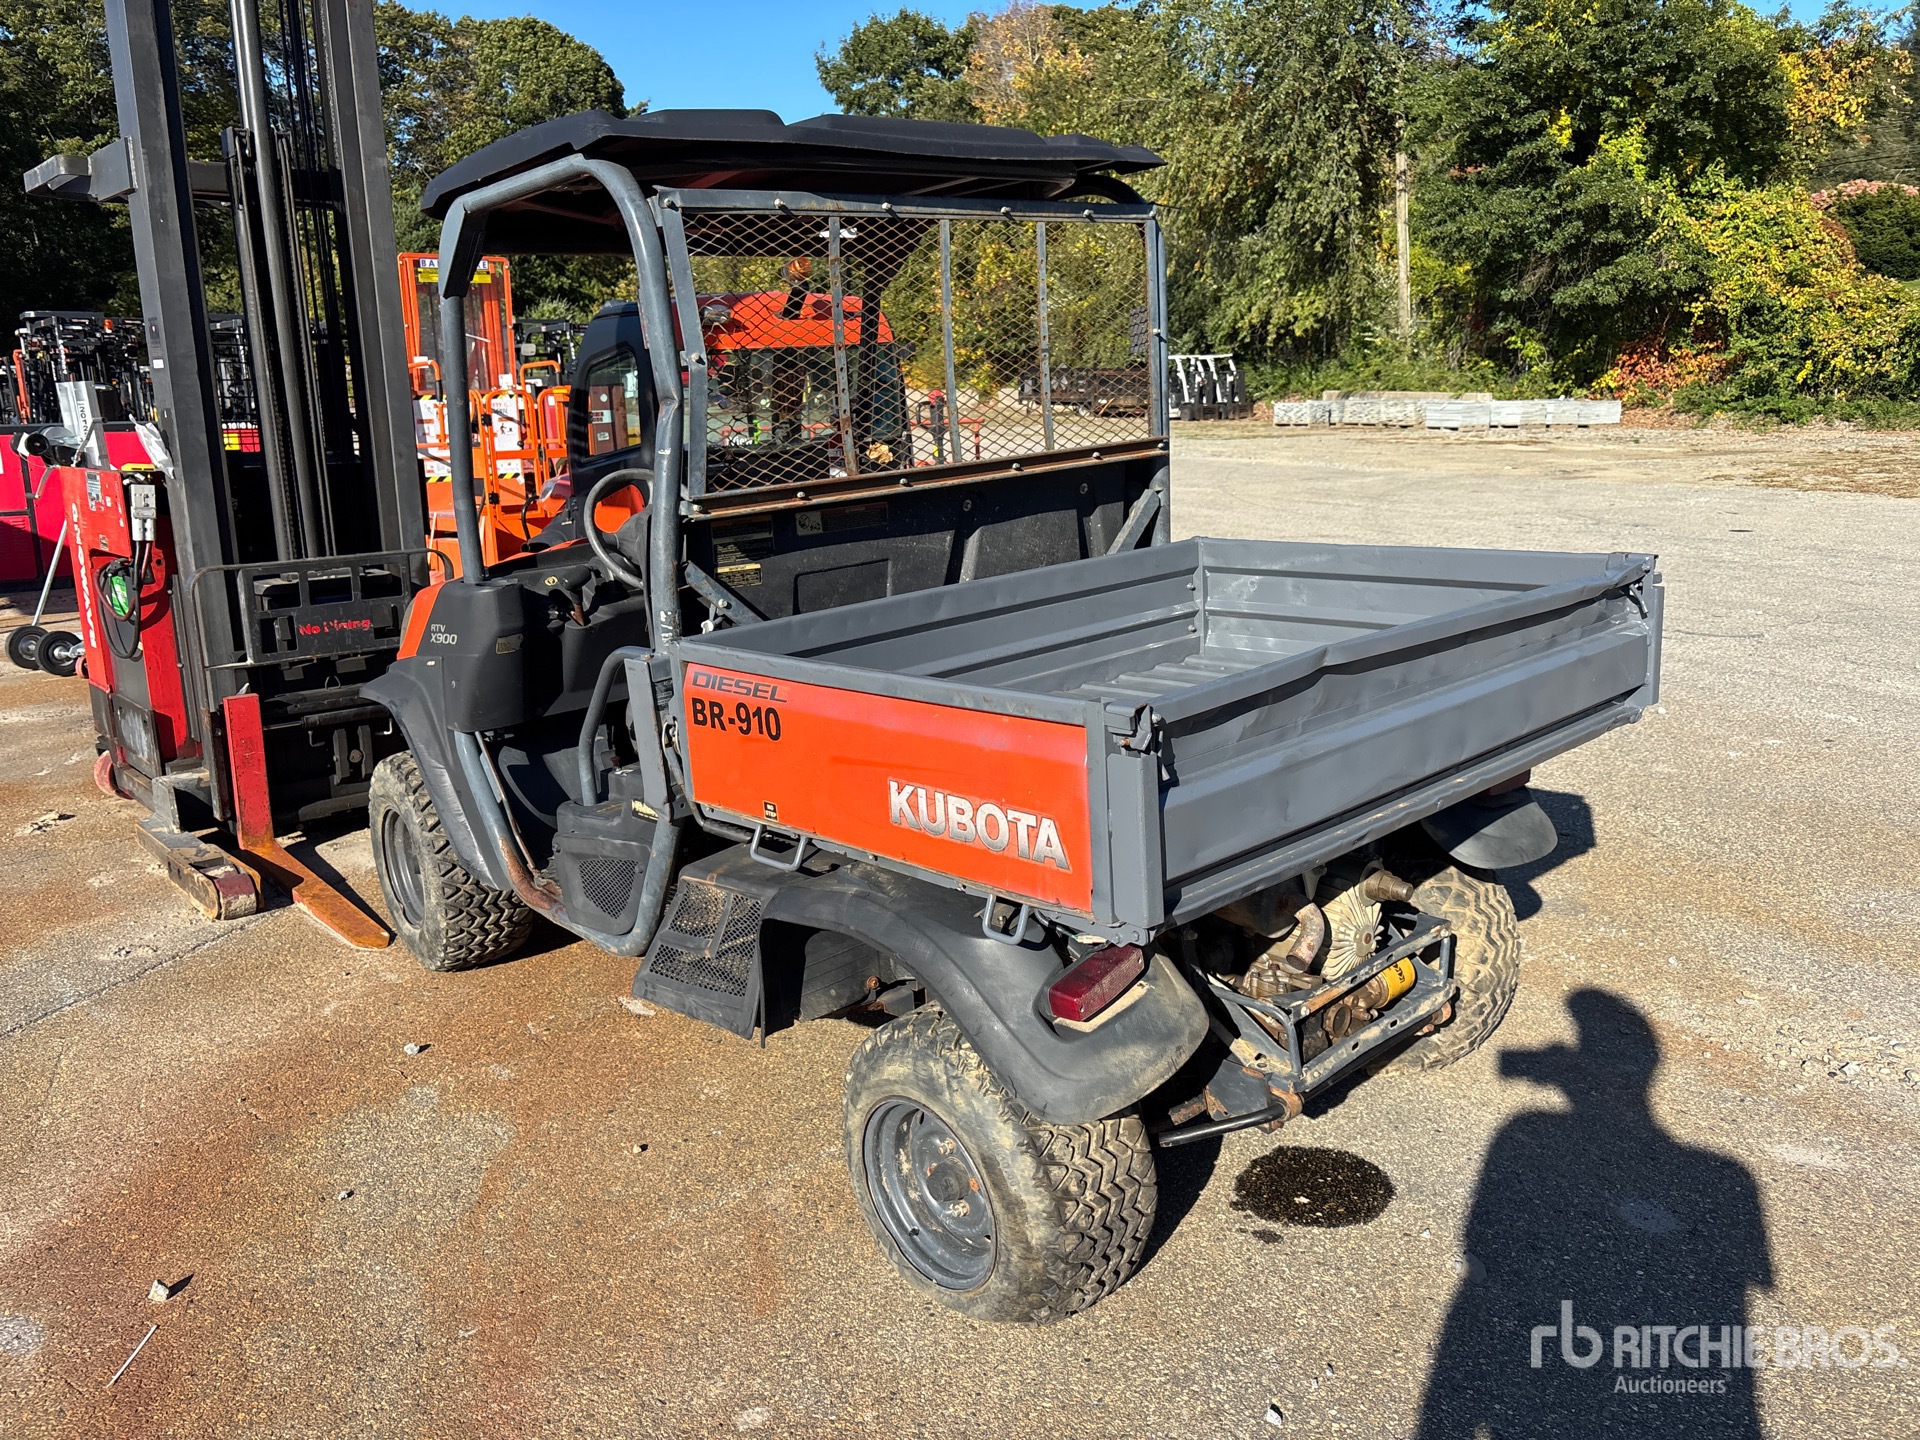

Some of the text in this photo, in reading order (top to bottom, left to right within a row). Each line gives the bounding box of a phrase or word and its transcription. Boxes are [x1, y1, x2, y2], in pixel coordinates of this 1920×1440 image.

[71, 502, 97, 648] RAYMOND
[299, 623, 321, 636] No
[430, 623, 446, 633] RTV
[430, 632, 458, 645] X900
[691, 670, 788, 704] DIESEL
[691, 697, 781, 741] BR-910
[888, 777, 1072, 872] KUBOTA
